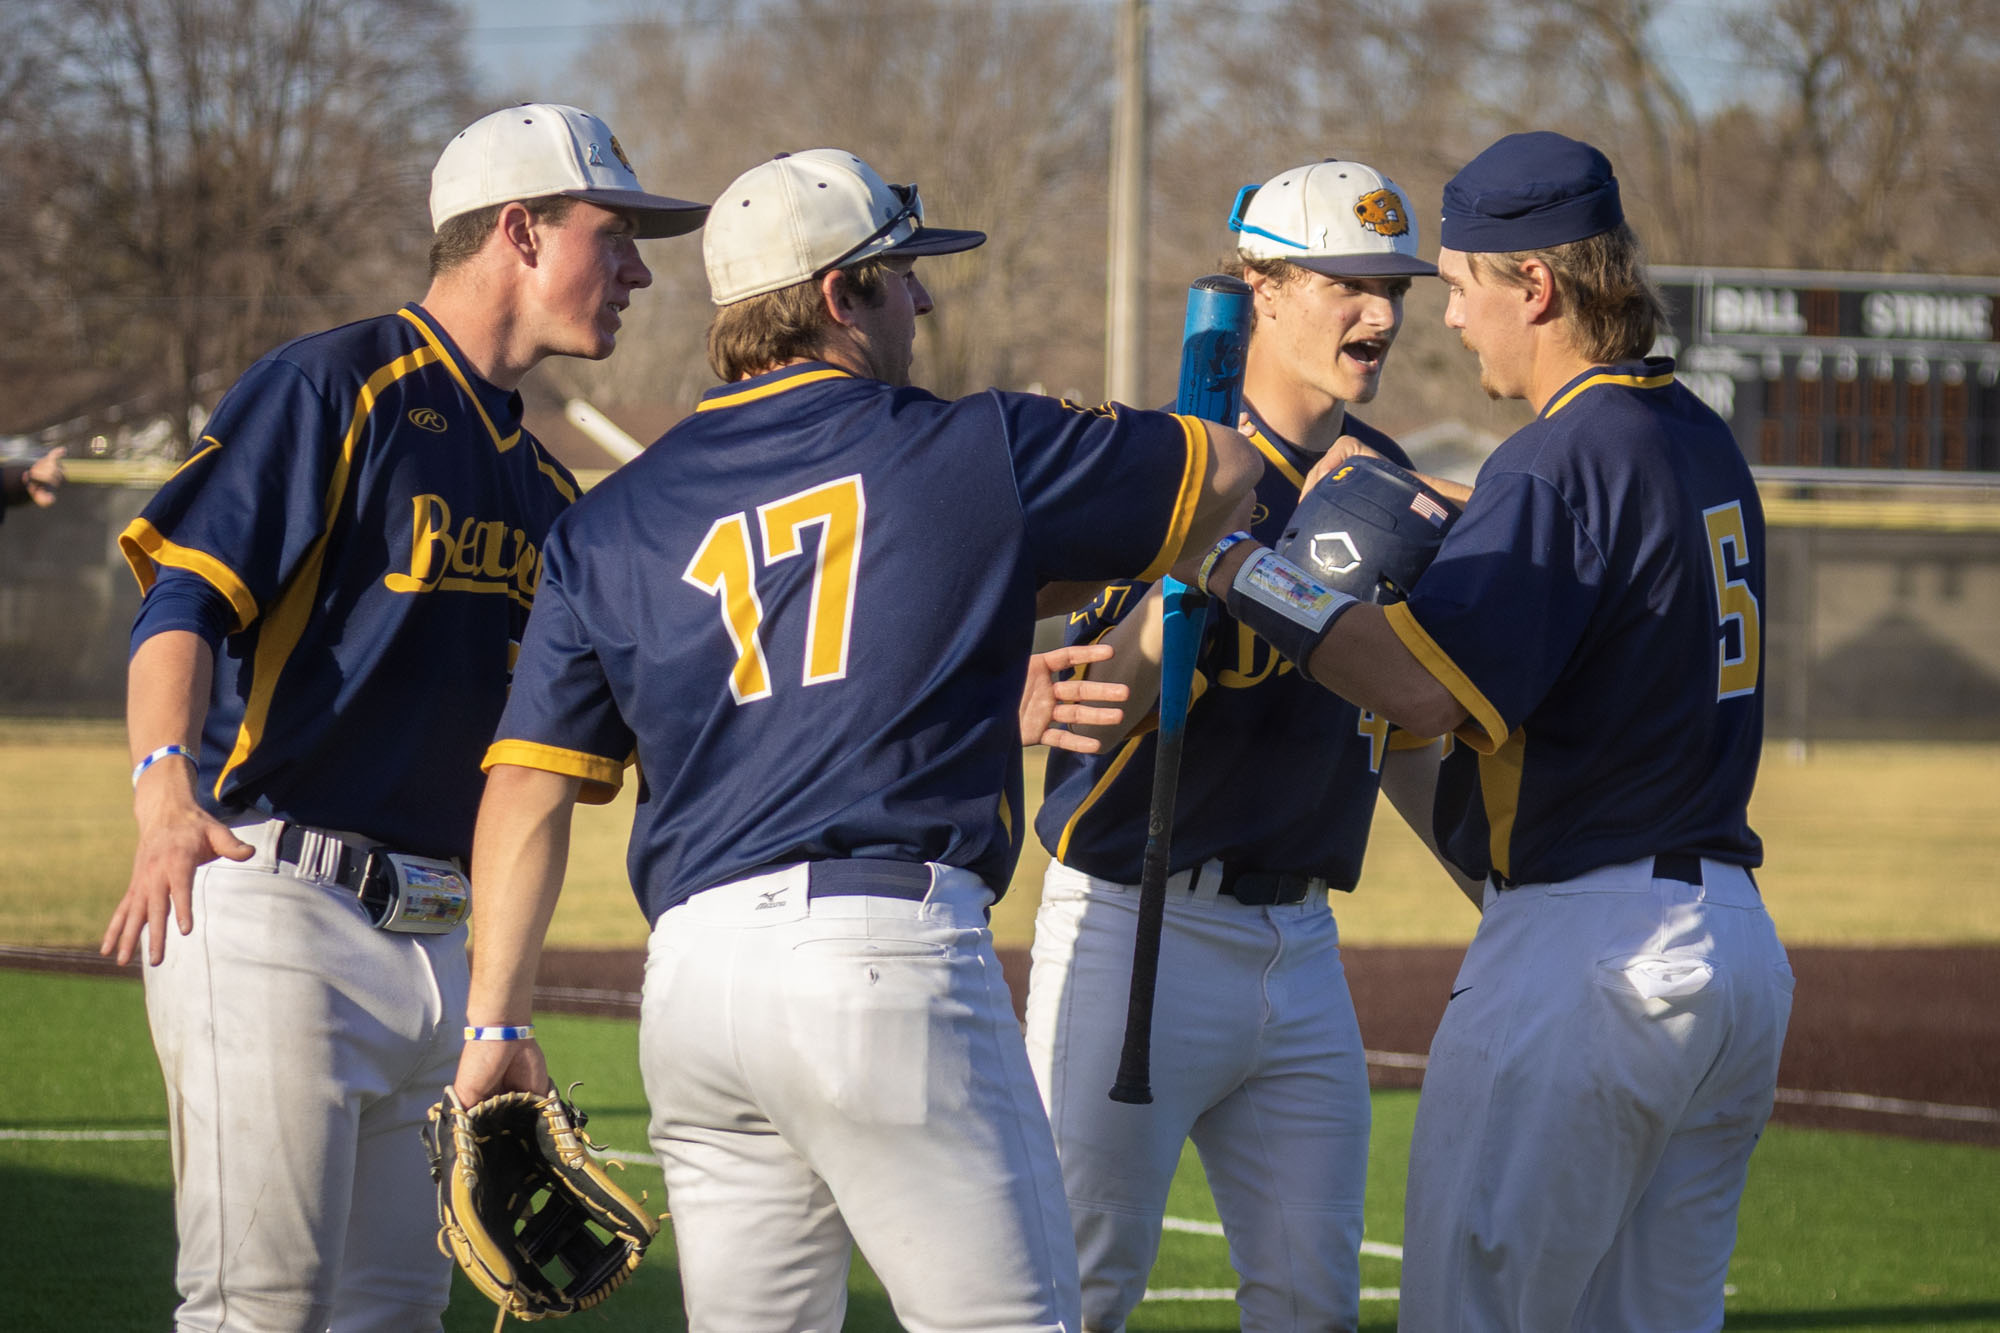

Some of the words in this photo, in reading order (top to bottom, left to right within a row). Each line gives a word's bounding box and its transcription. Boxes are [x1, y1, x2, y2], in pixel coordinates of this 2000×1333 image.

[1713, 288, 1807, 334] BALL
[1862, 292, 1993, 339] STRIKE
[681, 473, 866, 706] 17
[1702, 499, 1761, 703] 5
